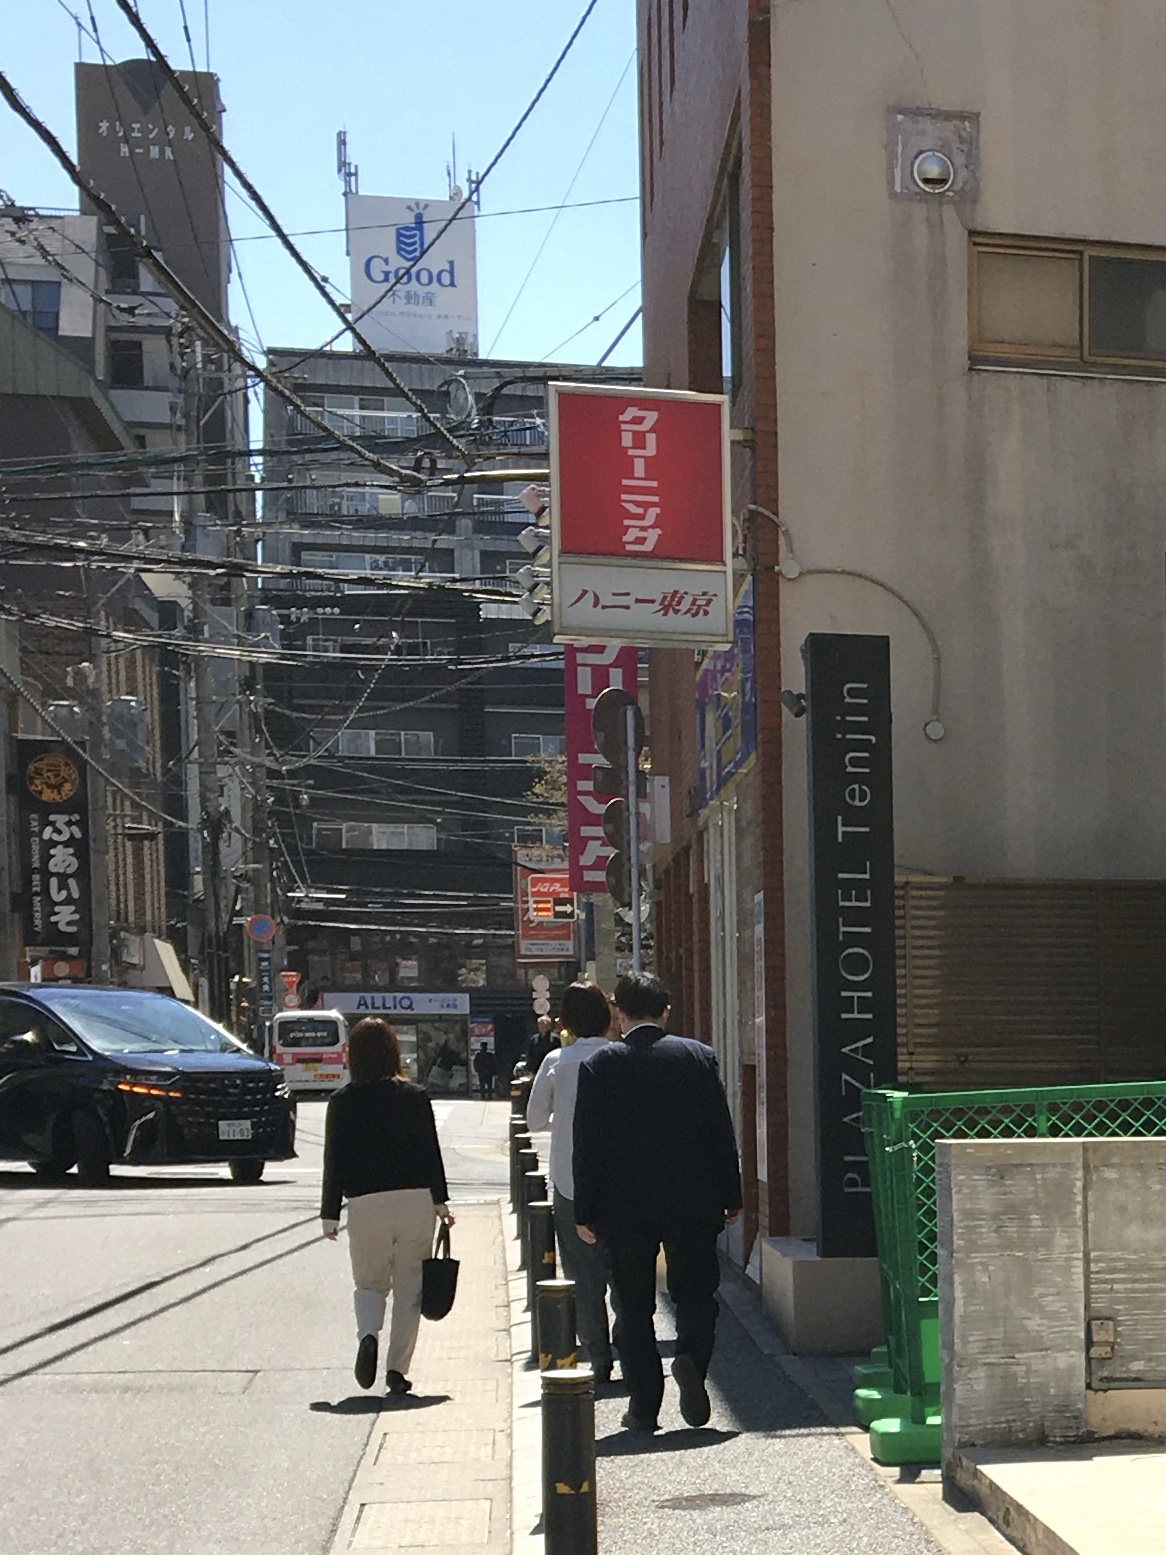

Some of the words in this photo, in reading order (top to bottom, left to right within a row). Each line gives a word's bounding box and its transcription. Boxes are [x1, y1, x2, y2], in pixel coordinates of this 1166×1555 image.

[98, 120, 194, 140] オリエンタル
[364, 255, 457, 288] Good
[389, 290, 437, 307] 不動産
[618, 406, 662, 552] クリーニング
[567, 589, 718, 617] ハニー東京
[835, 683, 876, 842] Tenjin
[42, 813, 82, 933] ぶあいそ
[837, 861, 873, 1019] HOTEL
[356, 995, 415, 1012] ALLIQ
